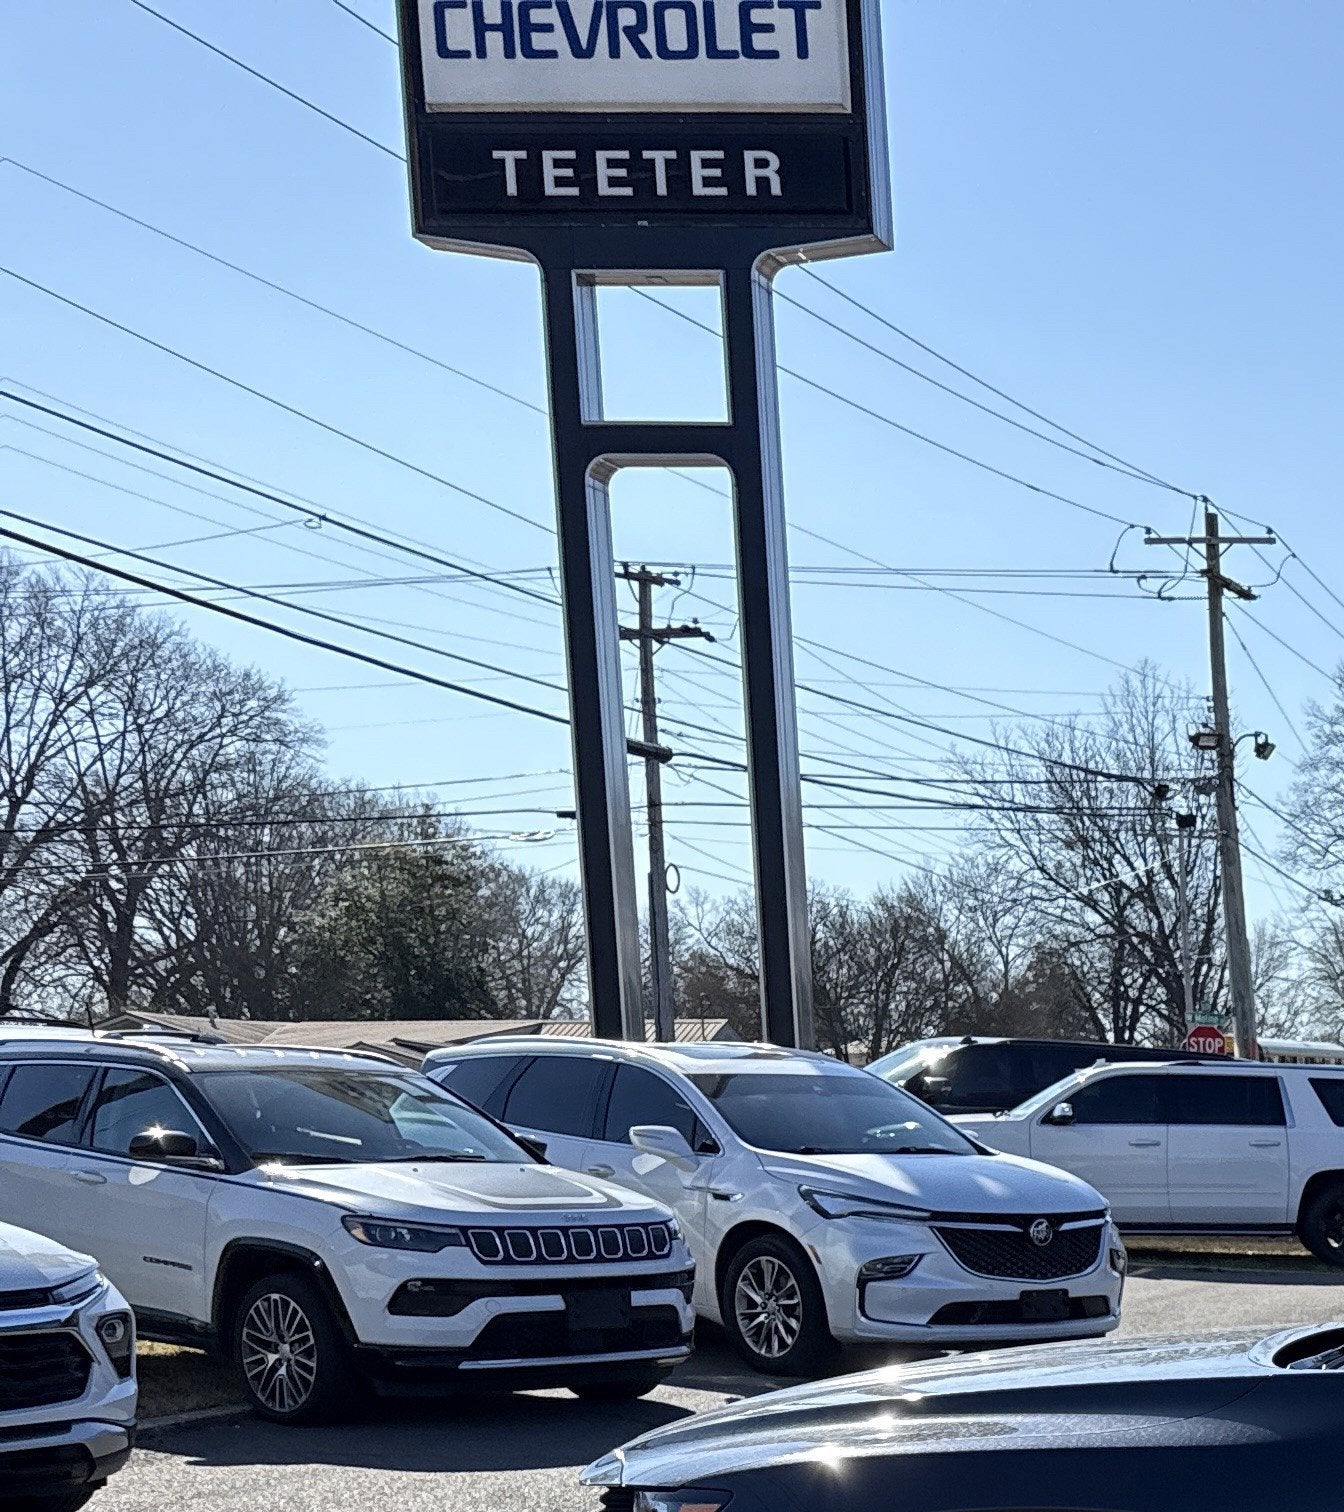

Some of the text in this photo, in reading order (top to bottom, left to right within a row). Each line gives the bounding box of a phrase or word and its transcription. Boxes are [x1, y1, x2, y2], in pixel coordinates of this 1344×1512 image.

[433, 0, 822, 60] CHEVROLET
[492, 149, 783, 197] TEETER
[1189, 1037, 1223, 1053] STOP
